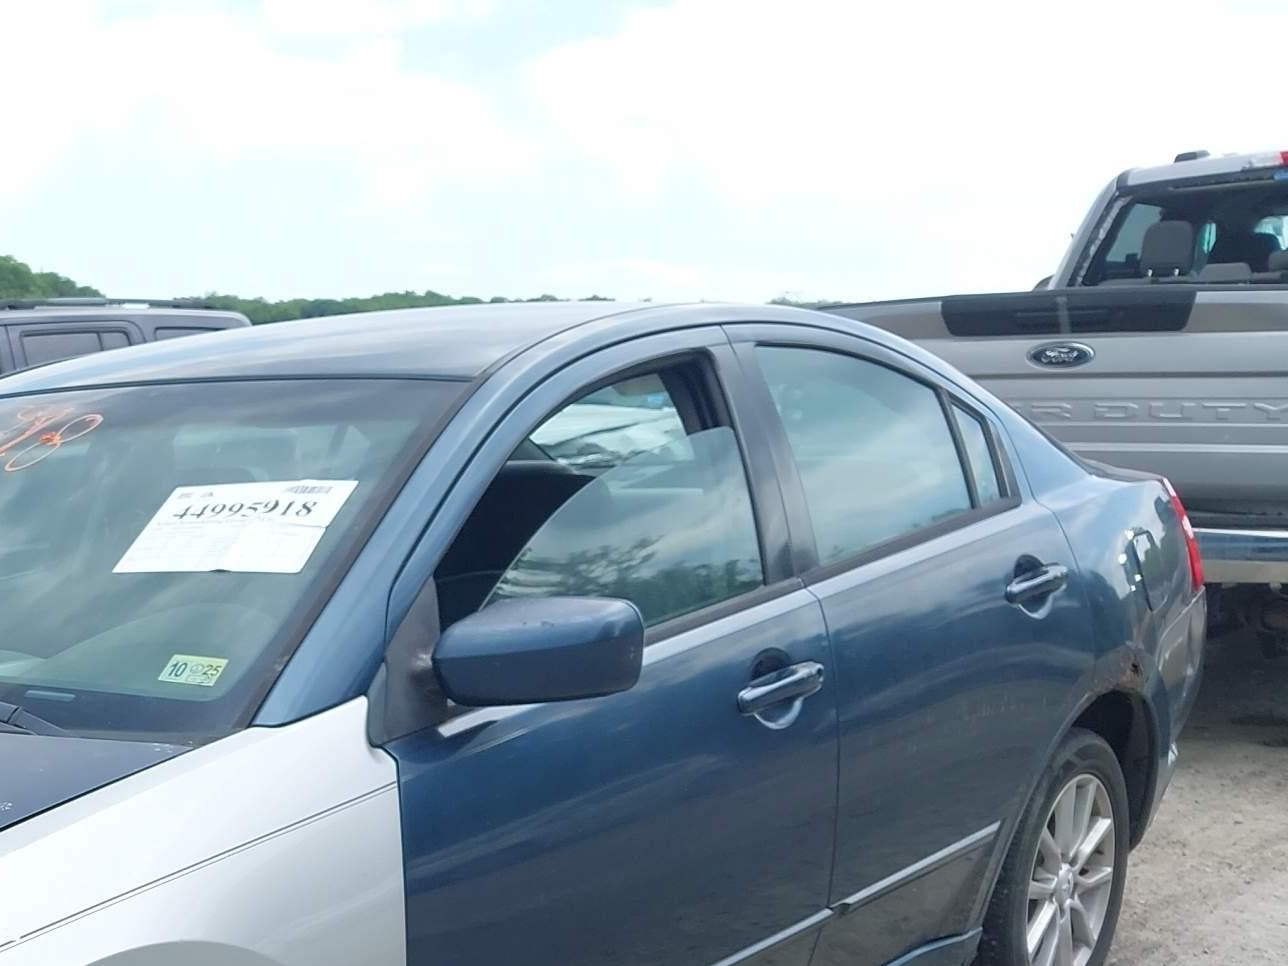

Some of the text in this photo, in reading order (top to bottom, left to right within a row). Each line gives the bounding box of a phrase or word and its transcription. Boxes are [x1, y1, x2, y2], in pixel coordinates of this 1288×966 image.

[172, 499, 318, 520] 44995918
[168, 662, 188, 677] 10
[202, 664, 223, 677] 25
